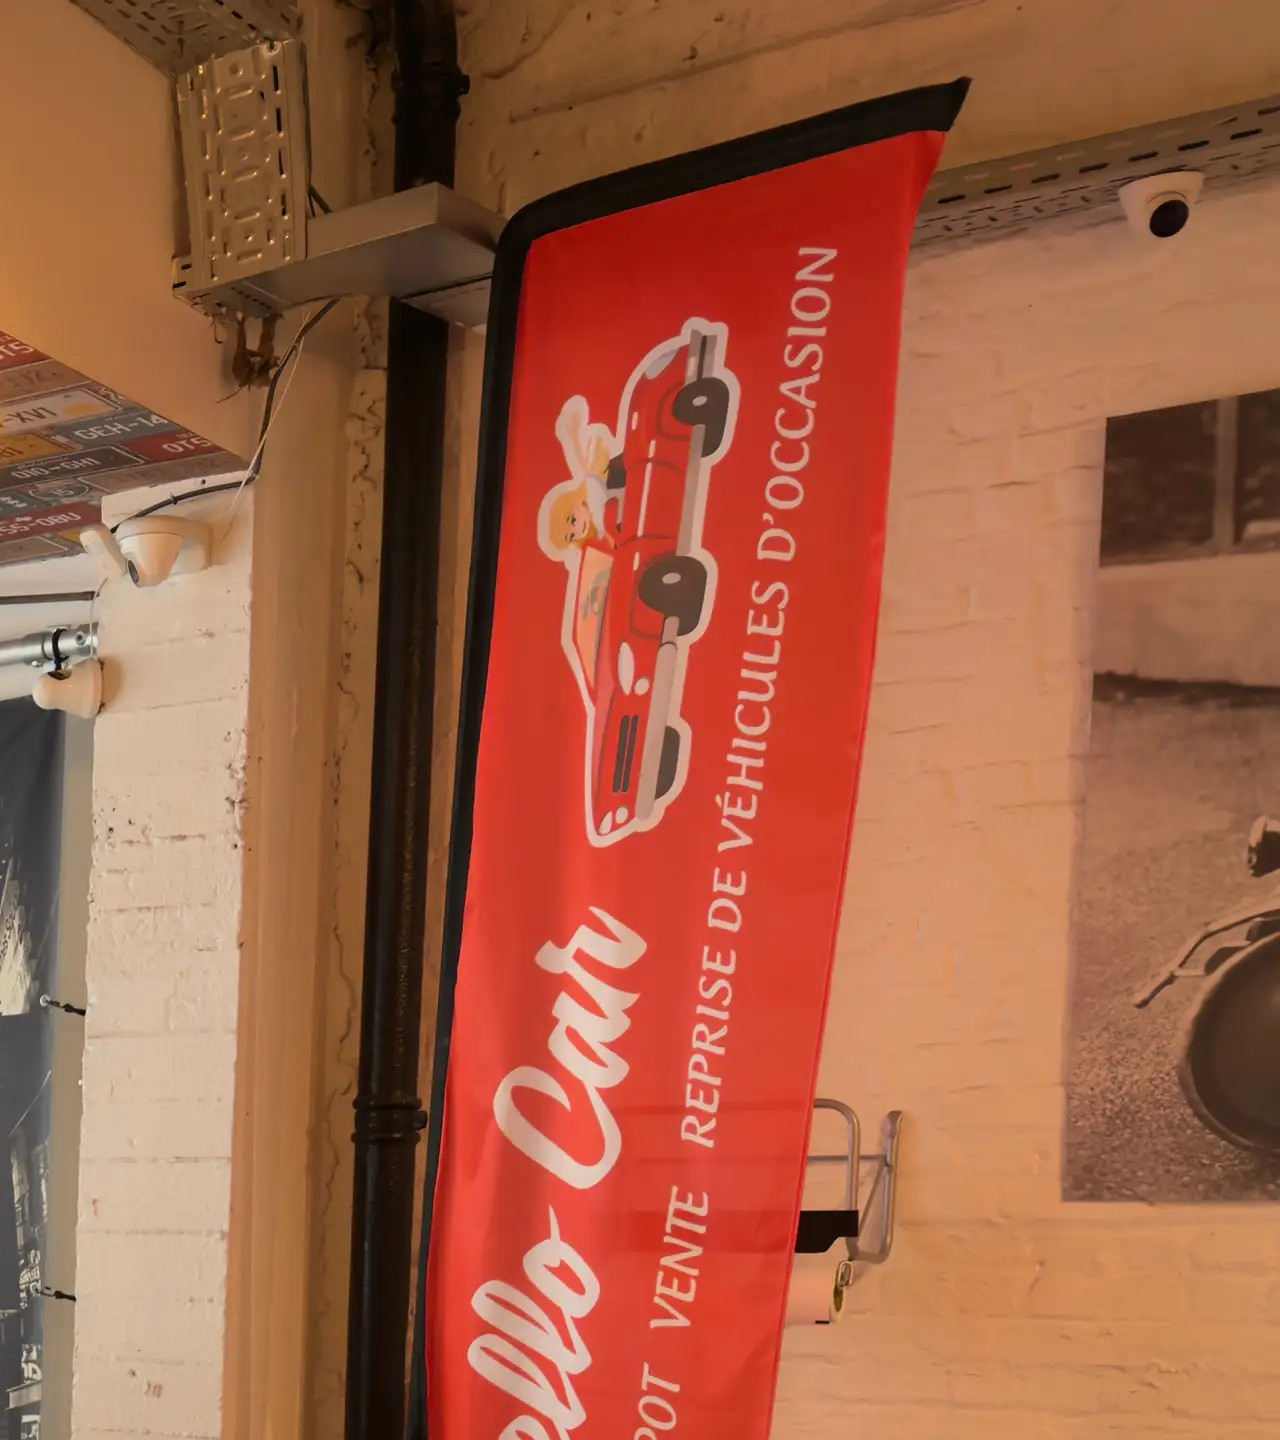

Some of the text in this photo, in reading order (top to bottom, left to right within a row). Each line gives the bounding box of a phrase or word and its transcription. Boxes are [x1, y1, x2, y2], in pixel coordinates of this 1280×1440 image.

[756, 246, 840, 562] D'OCCASION
[715, 581, 790, 853] VÉHICULES
[706, 868, 747, 932] DE
[492, 905, 647, 1191] Car
[681, 945, 737, 1149] REPRISE
[650, 1186, 708, 1330] VENTE
